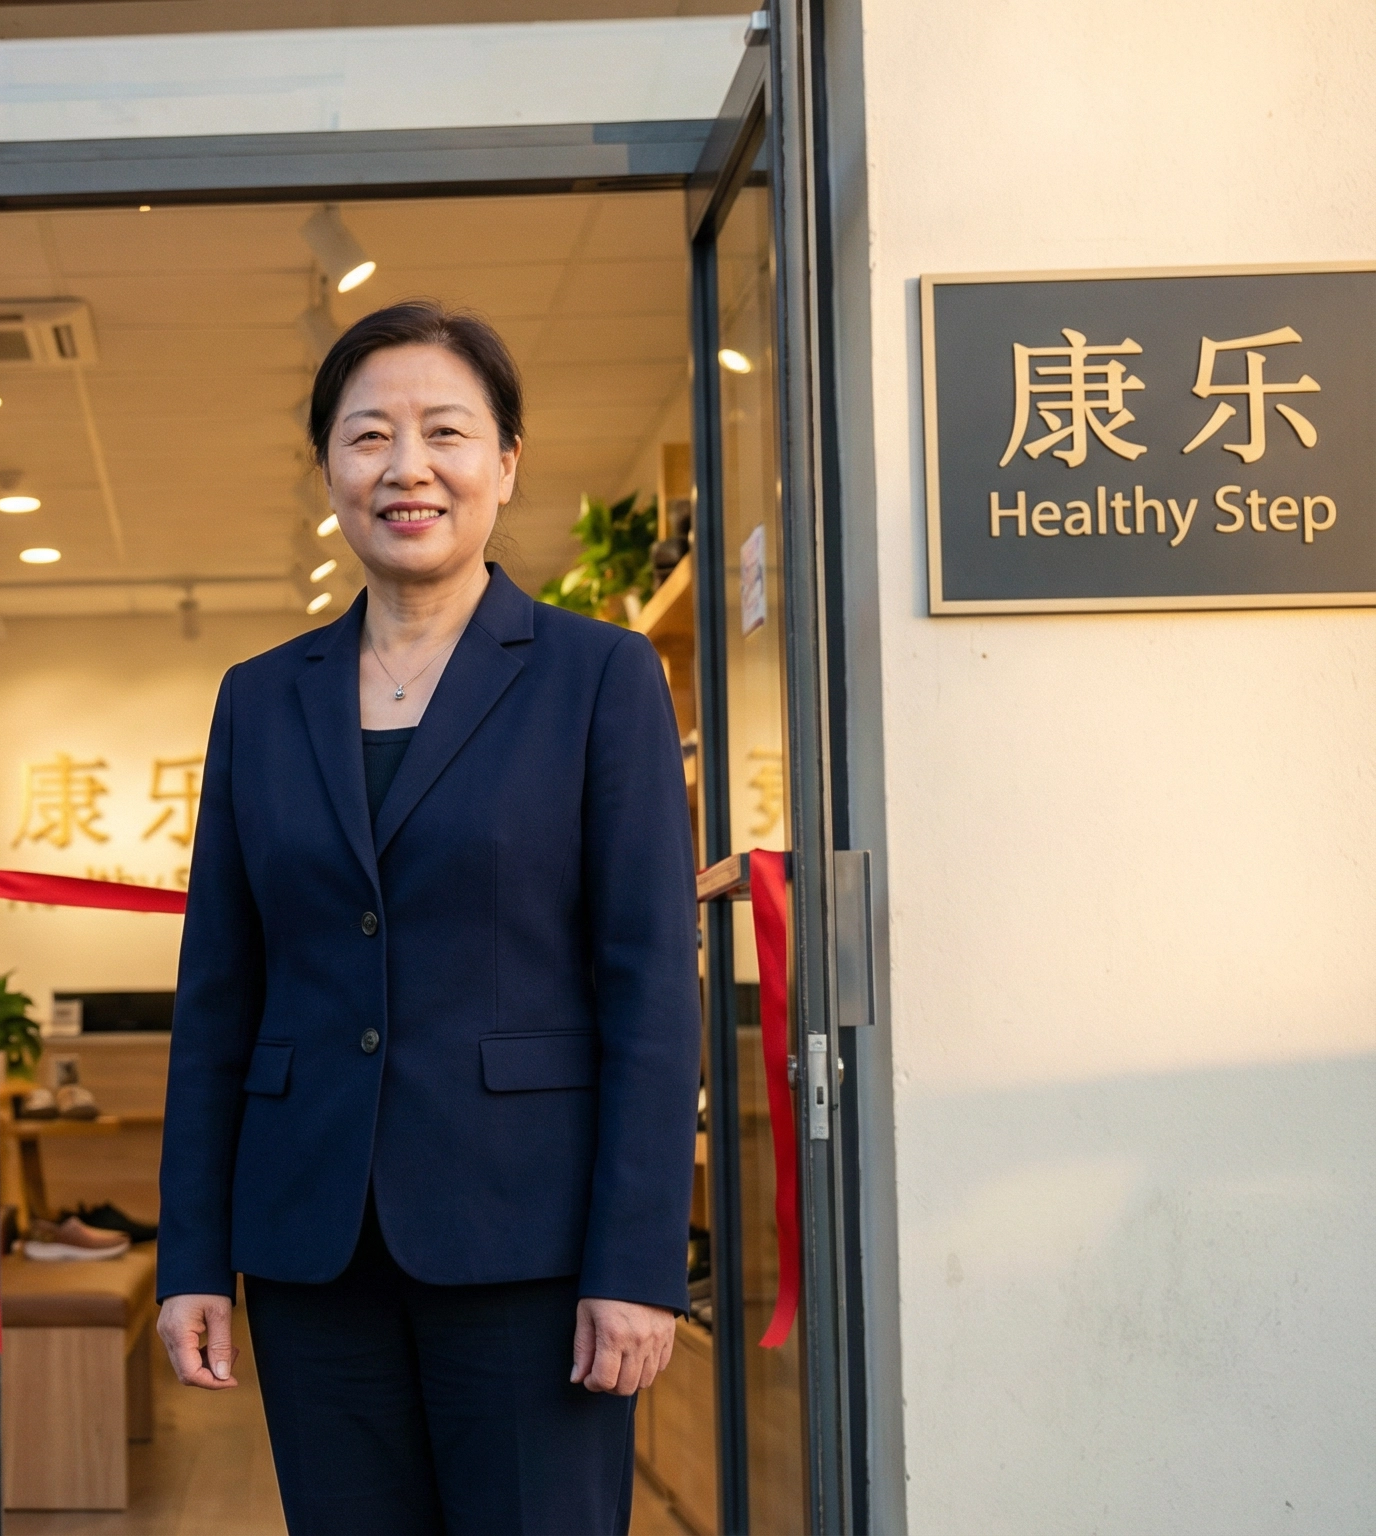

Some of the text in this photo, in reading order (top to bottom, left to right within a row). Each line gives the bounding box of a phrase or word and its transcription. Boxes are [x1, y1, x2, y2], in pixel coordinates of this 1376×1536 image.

[999, 326, 1322, 468] 康乐
[989, 485, 1338, 547] Healthy Step
